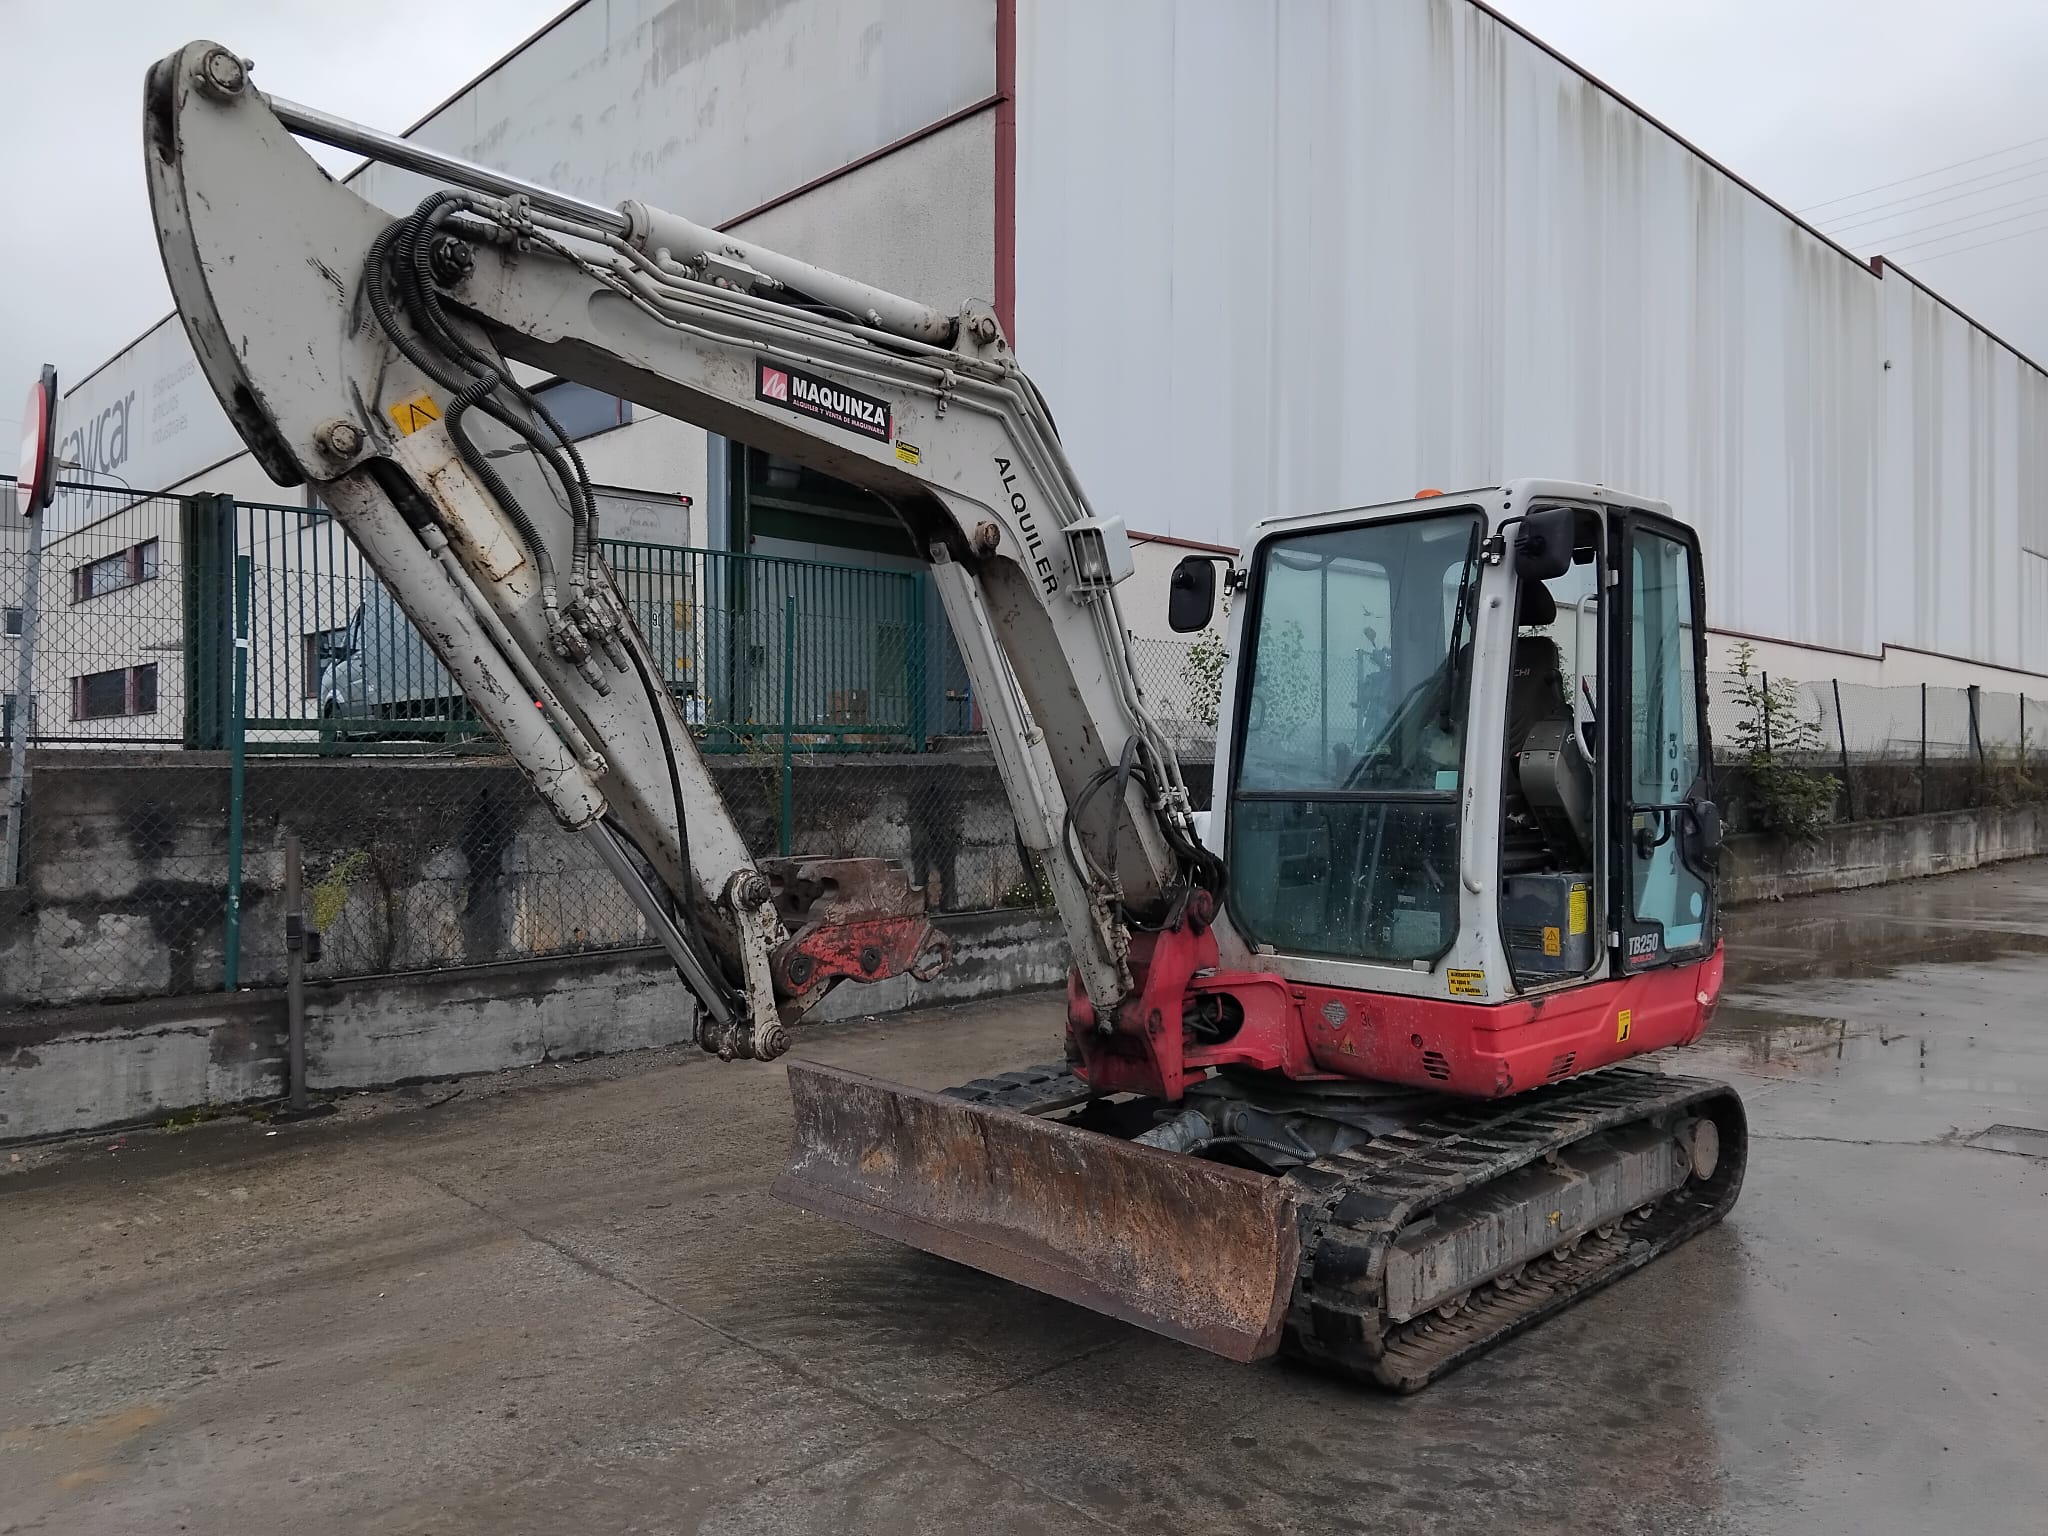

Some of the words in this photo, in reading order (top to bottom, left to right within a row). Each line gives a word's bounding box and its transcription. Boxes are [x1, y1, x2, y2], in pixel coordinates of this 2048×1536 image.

[792, 376, 886, 427] MAQUINZA
[792, 399, 820, 414] ALQUILER
[824, 409, 843, 422] VENTA
[843, 416, 851, 424] DE
[851, 419, 885, 435] MAQUINARIA
[994, 457, 1058, 595] ALQUILER
[1629, 933, 1659, 955] TB250
